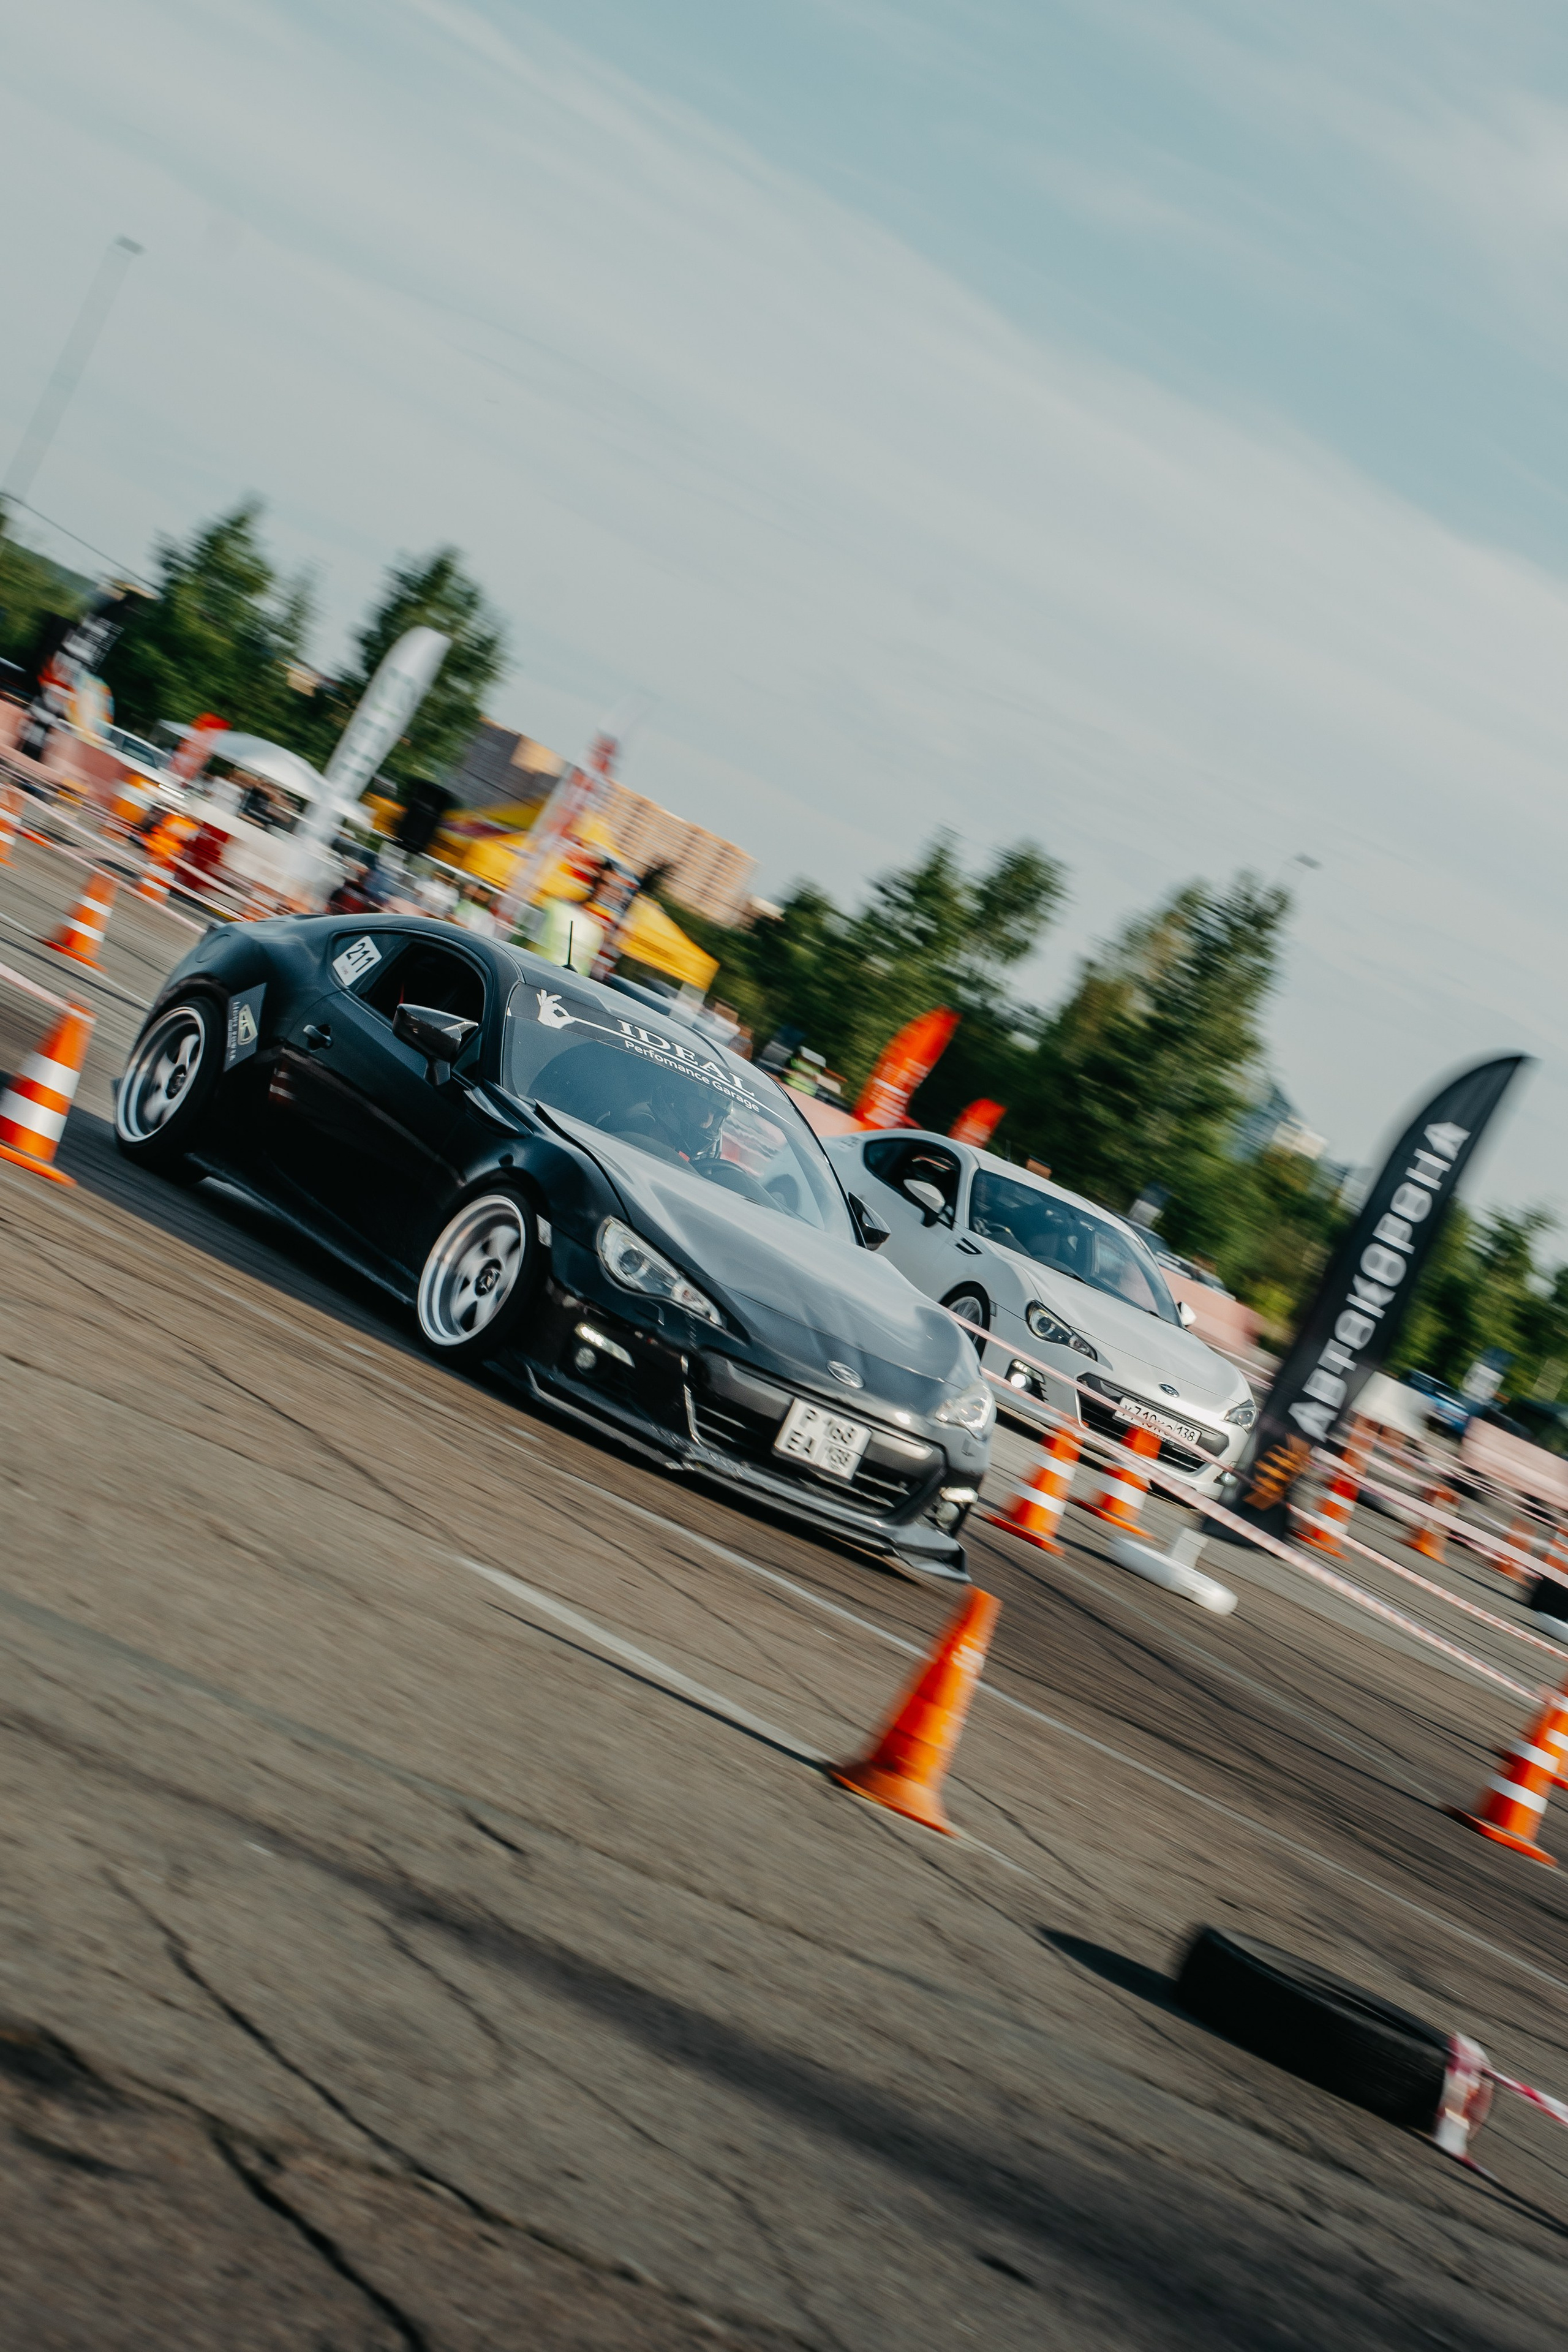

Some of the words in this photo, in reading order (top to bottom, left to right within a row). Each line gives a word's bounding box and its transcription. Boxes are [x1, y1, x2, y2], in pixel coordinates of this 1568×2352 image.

[345, 942, 375, 973] 211
[617, 1019, 755, 1097] IDEAL
[624, 1040, 710, 1084] Perfomance
[712, 1080, 760, 1112] Garage
[1288, 1121, 1471, 1444] АВТОКОРОНА
[1177, 1426, 1195, 1442] 138
